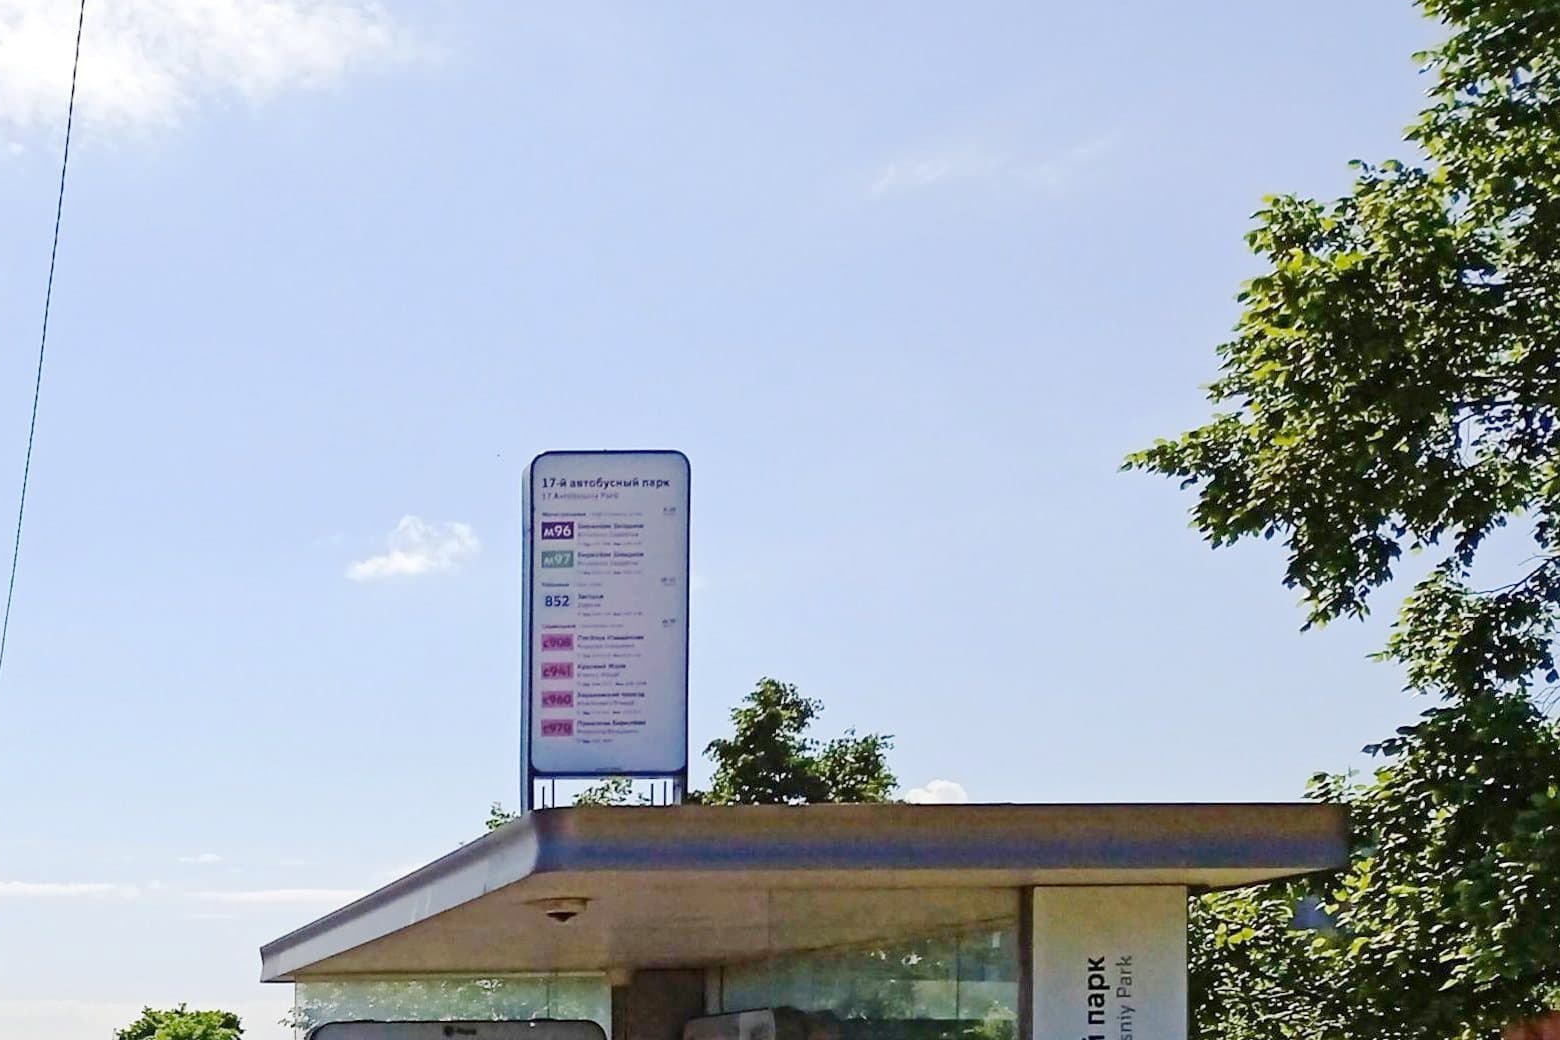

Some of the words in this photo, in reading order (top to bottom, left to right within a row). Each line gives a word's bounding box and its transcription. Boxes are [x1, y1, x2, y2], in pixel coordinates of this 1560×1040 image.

[542, 477, 568, 489] 17-й
[570, 477, 640, 490] автобусный
[642, 479, 670, 490] парк
[545, 595, 570, 607] 852
[1087, 955, 1111, 1025] парк
[1115, 955, 1133, 998] Park
